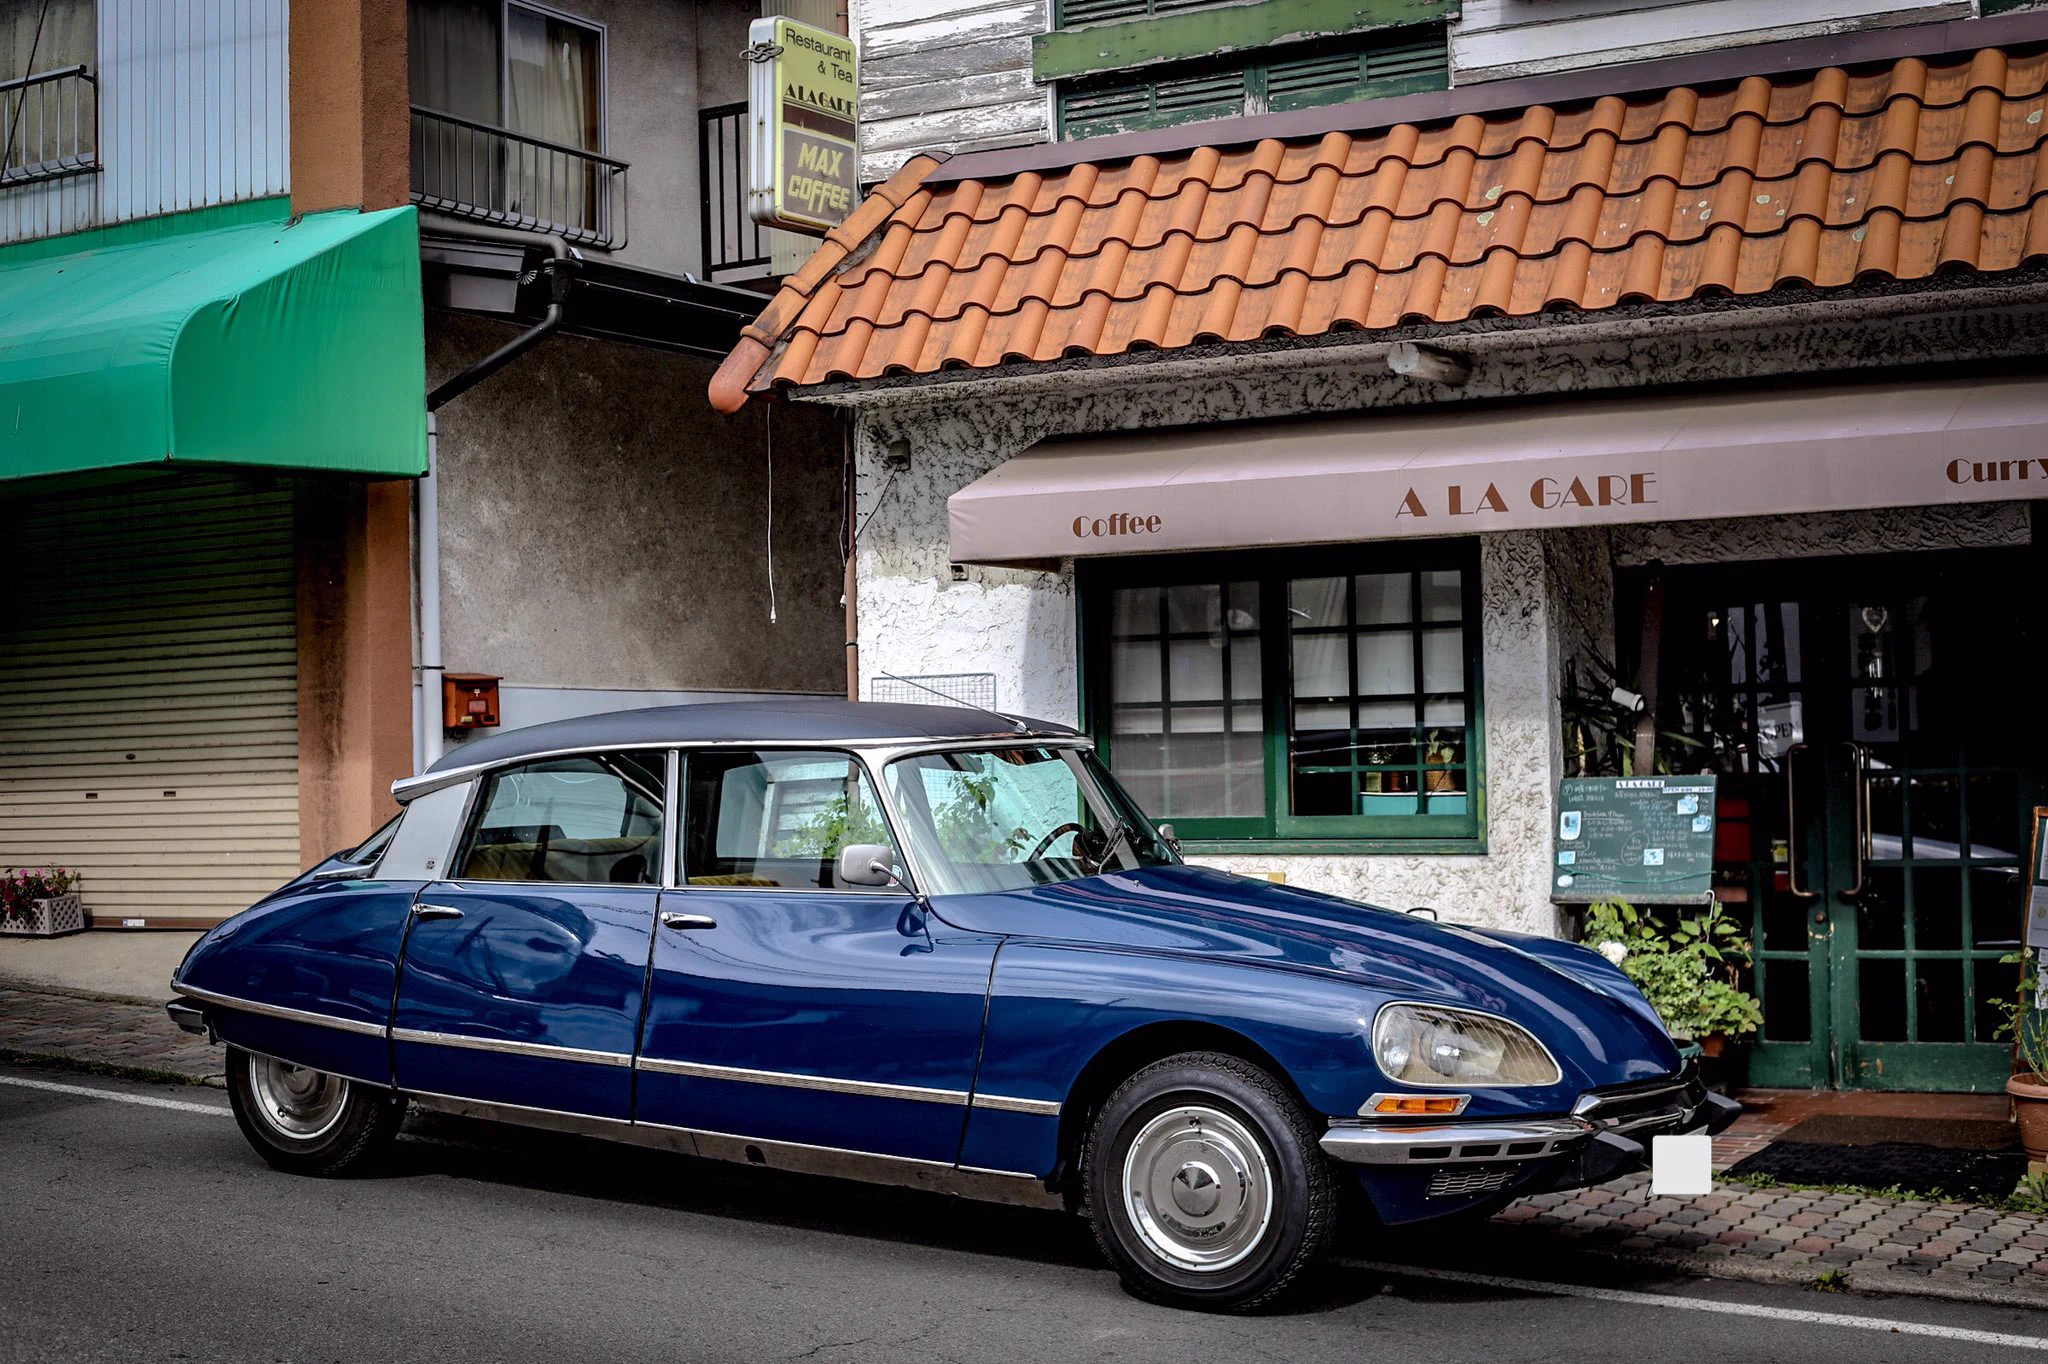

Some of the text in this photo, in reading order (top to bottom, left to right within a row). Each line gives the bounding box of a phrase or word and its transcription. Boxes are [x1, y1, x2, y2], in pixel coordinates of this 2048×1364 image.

[786, 27, 851, 63] Restaurant
[817, 60, 853, 83] & Tea
[798, 142, 844, 177] MAX
[787, 174, 851, 213] COFFEE
[1395, 472, 1659, 519] A LA GARE
[1072, 512, 1162, 538] Coffee
